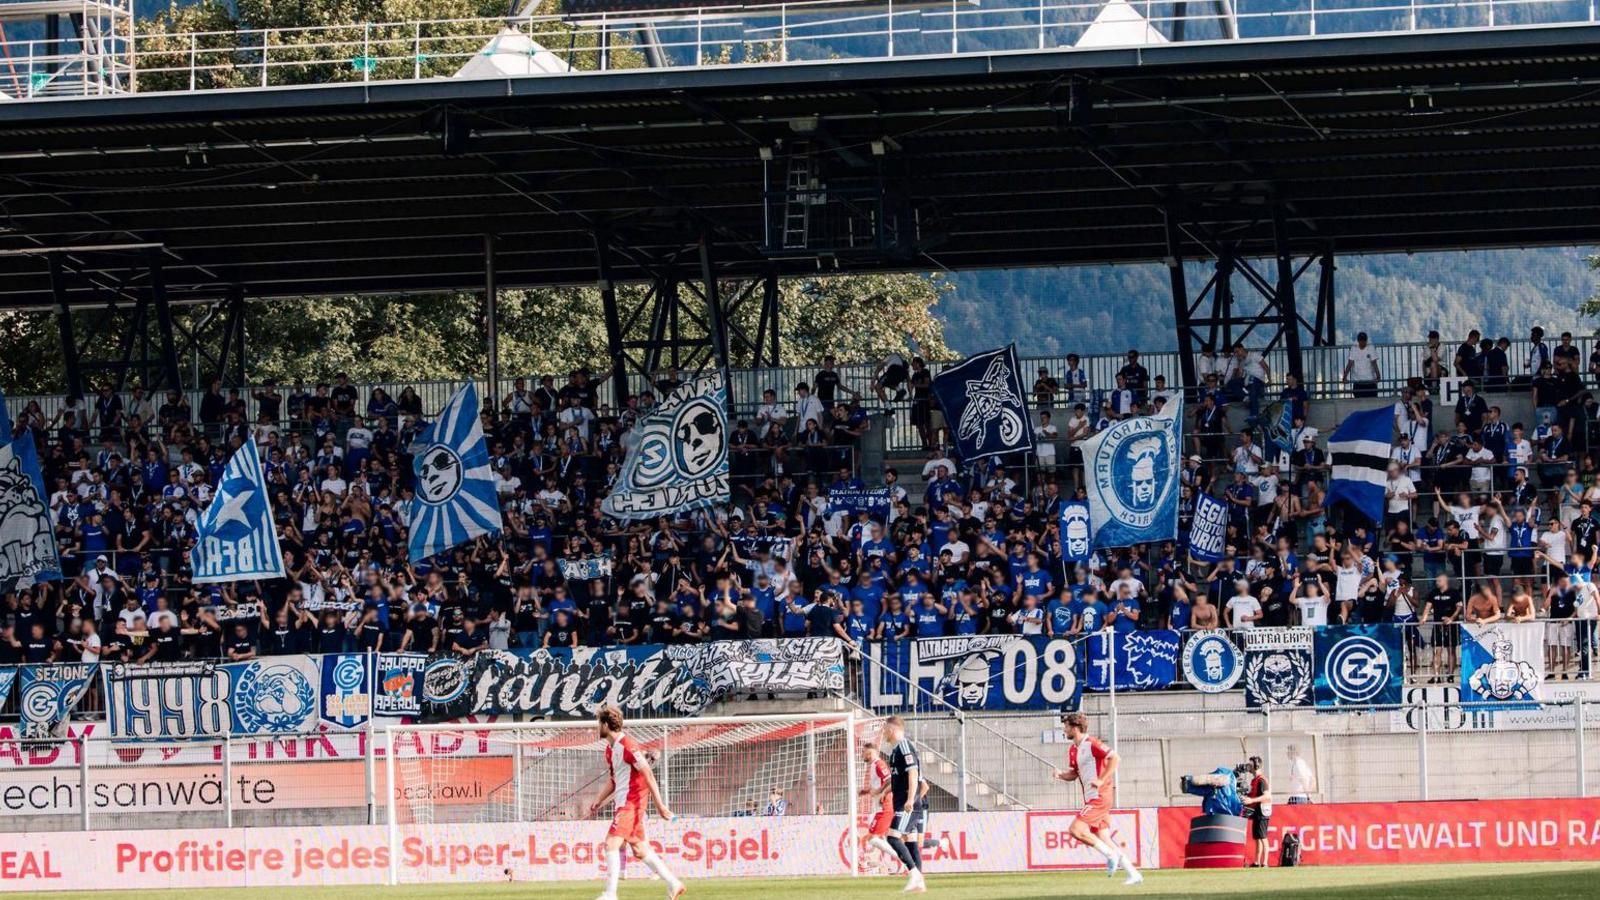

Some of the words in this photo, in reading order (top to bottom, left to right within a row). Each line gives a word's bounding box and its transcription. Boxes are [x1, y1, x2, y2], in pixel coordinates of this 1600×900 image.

[1196, 493, 1227, 525] LEGI
[918, 639, 969, 659] ALTACHER
[1184, 635, 1200, 674] LEGION
[1203, 629, 1244, 667] HARURM
[1246, 633, 1281, 646] ULTRA
[1283, 631, 1313, 646] EKIPA
[36, 665, 90, 682] SEZIONE
[379, 656, 426, 673] GRUPPO
[1003, 639, 1077, 705] 08
[111, 670, 233, 739] 1998
[236, 661, 263, 734] Bulldogs
[0, 774, 276, 811] echsanwäte
[921, 830, 978, 861] EAL
[1366, 820, 1487, 851] GEWALT
[1495, 819, 1558, 848] UND
[117, 839, 284, 875] Profitiere
[291, 838, 391, 877] jedes
[402, 829, 779, 875] Super-Leage-Spiel.
